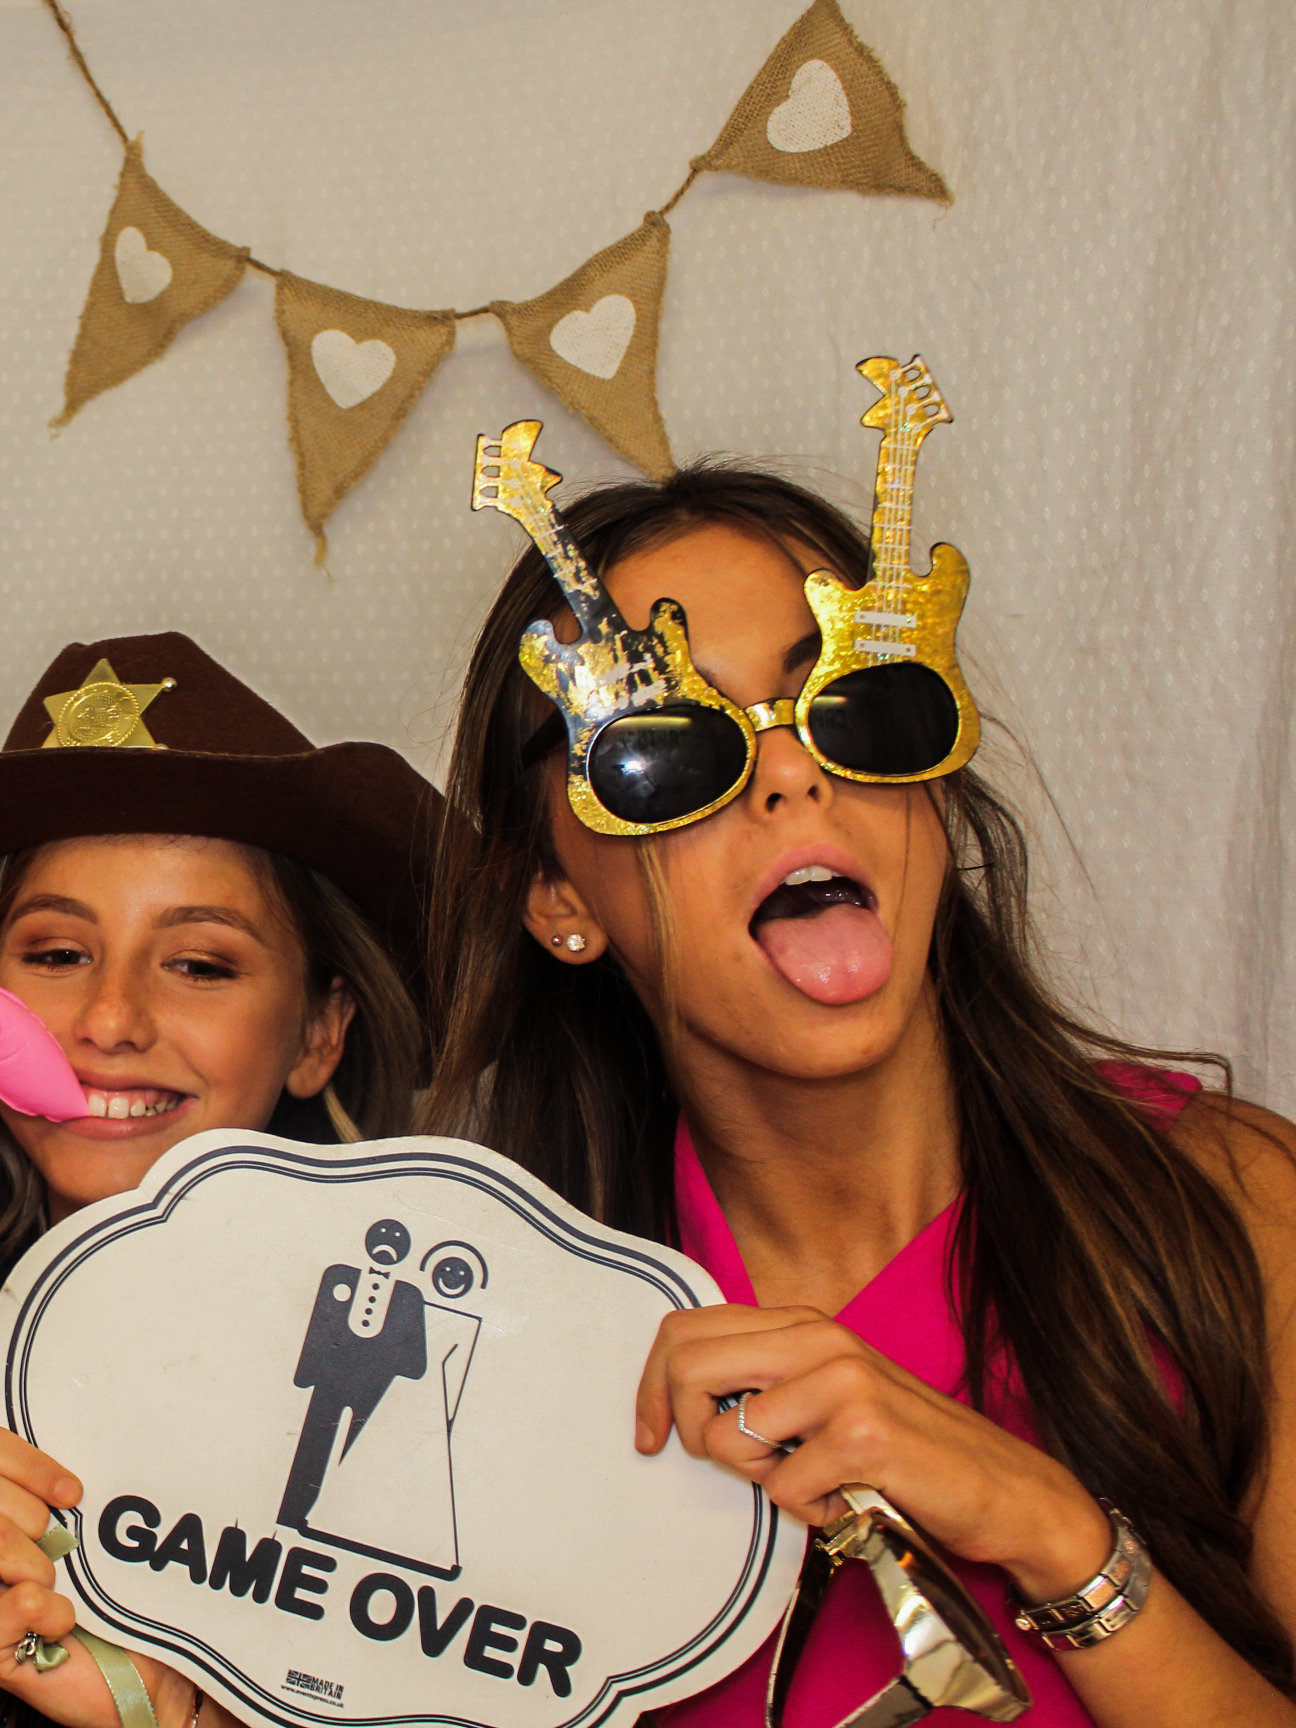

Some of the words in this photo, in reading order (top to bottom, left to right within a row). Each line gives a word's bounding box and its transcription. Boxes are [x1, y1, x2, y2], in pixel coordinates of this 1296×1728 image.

[98, 1495, 338, 1621] GAME
[349, 1572, 582, 1698] OVER
[310, 1684, 342, 1699] BRITAIN
[311, 1677, 334, 1690] MADE
[335, 1684, 344, 1692] IN
